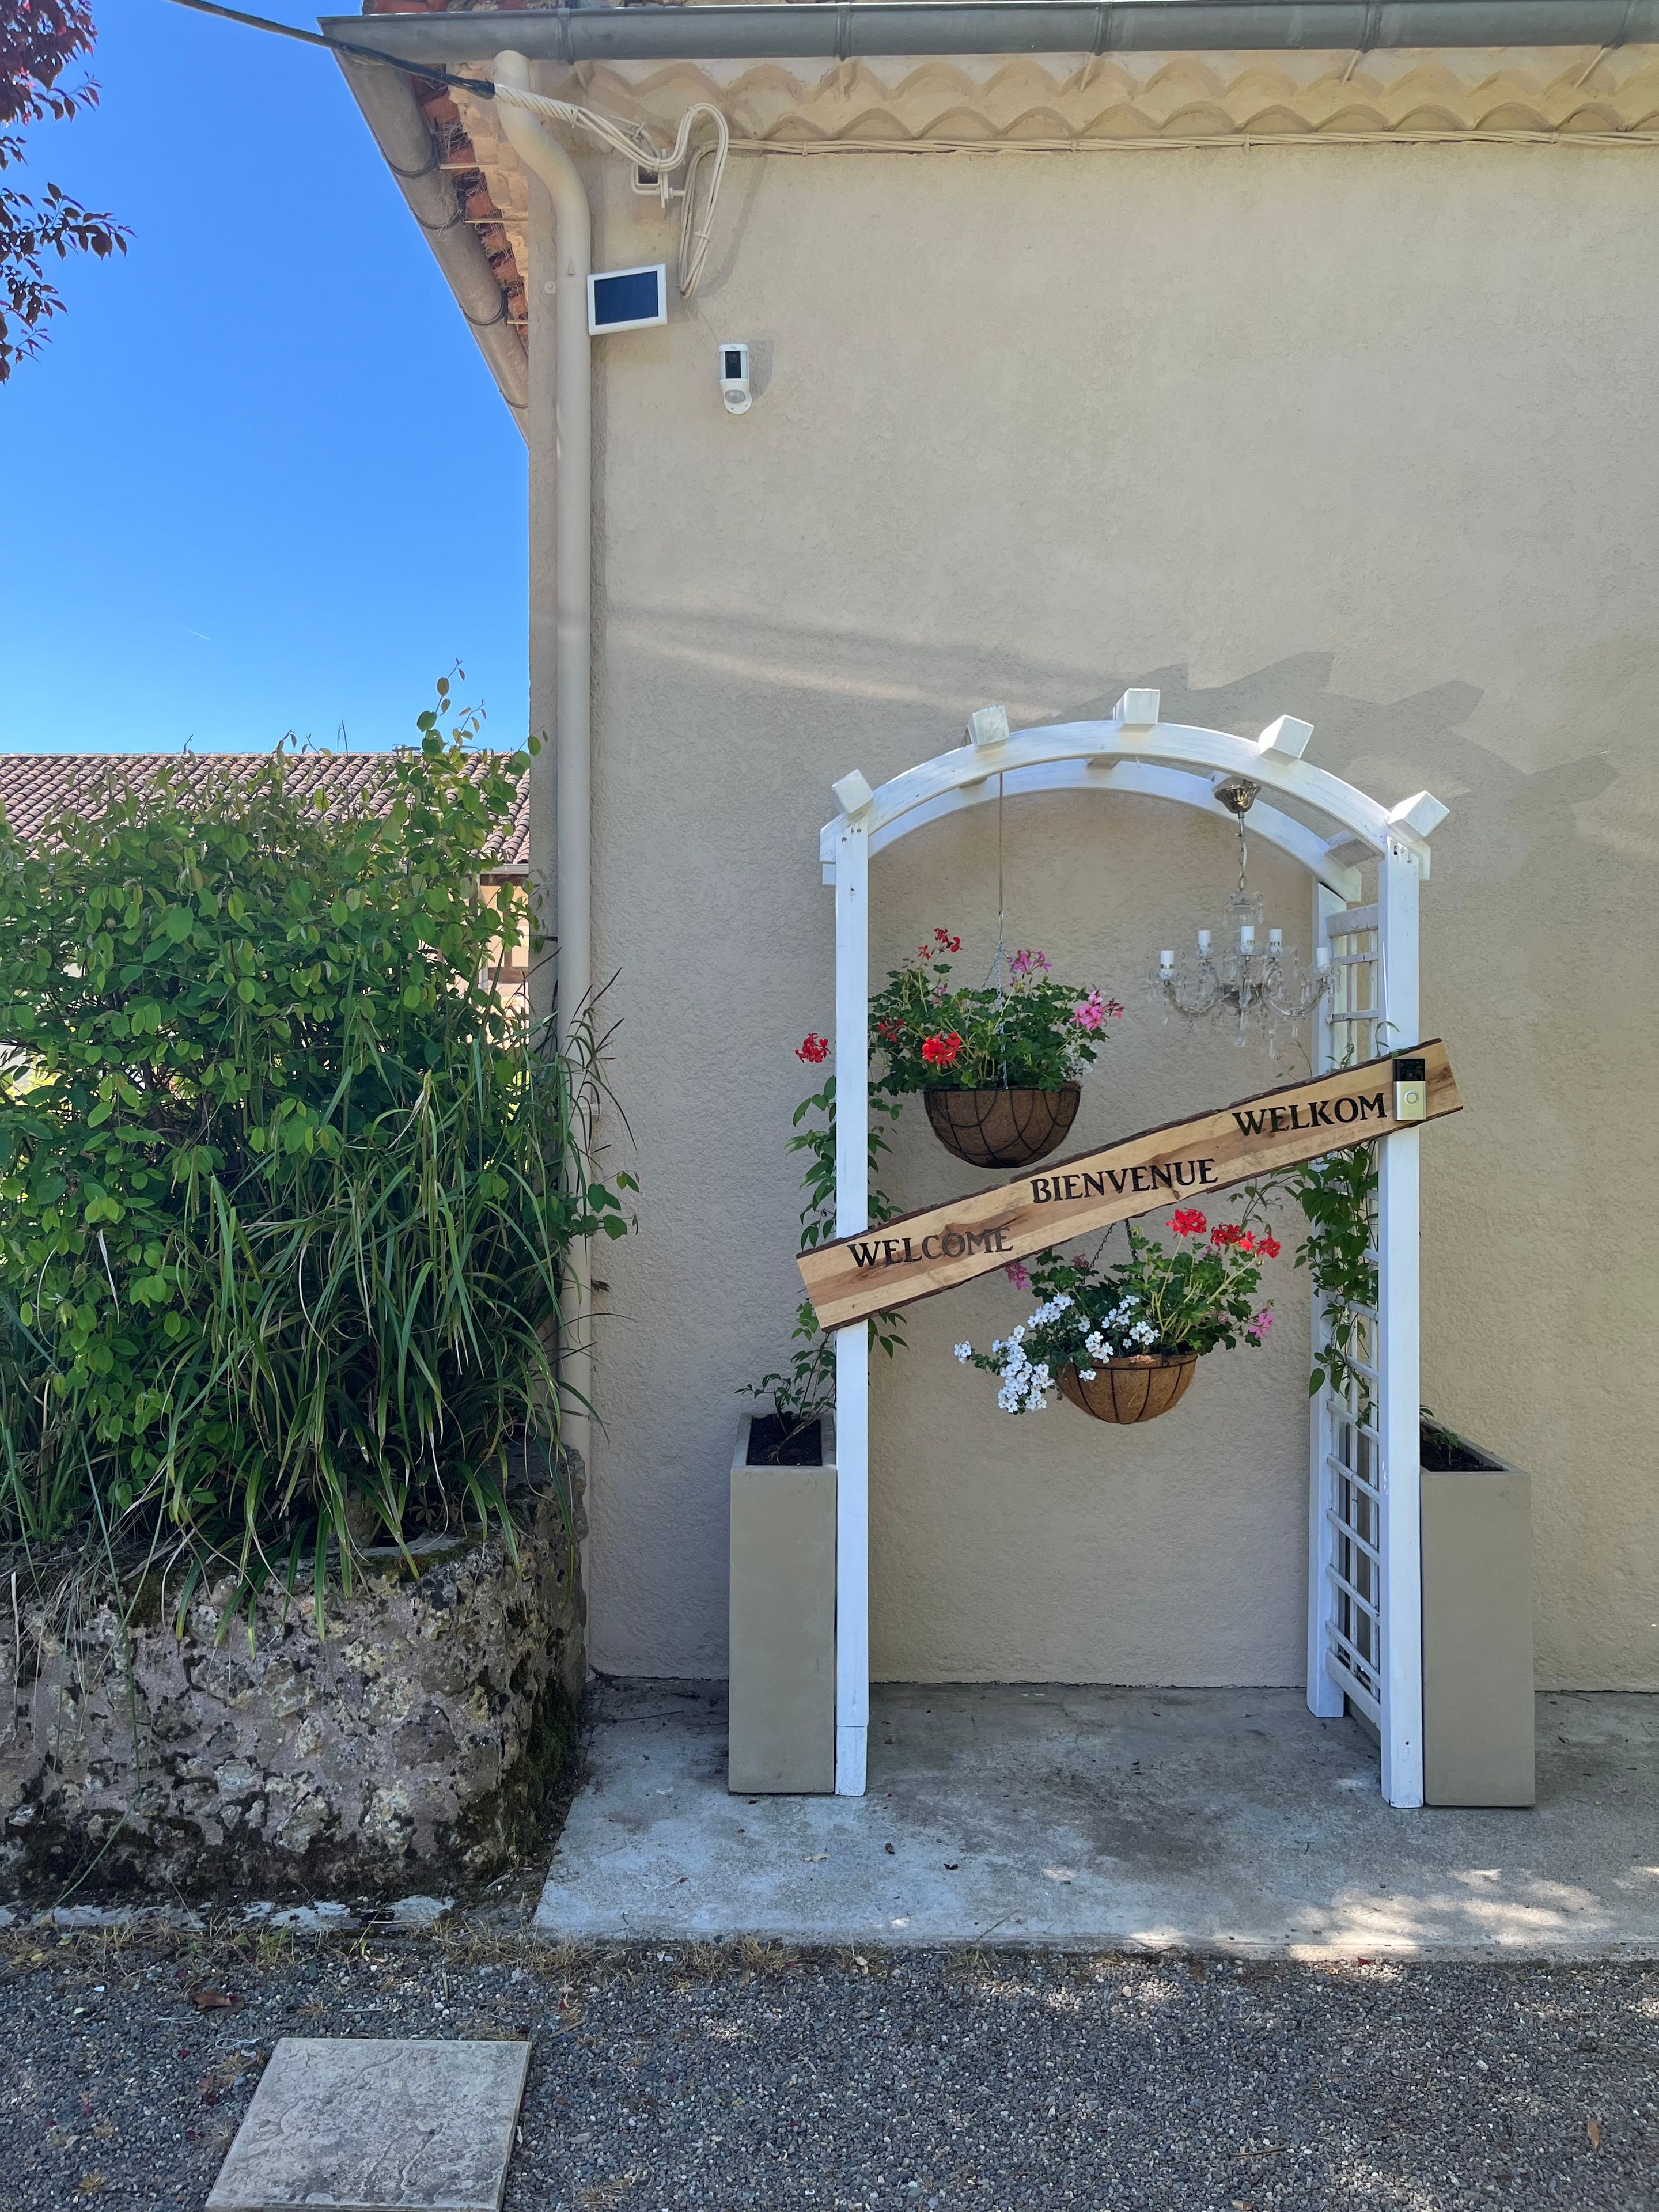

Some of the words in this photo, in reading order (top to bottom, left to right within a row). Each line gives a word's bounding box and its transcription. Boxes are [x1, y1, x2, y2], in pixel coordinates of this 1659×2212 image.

[847, 1226, 1013, 1267] WELCOME
[1029, 1158, 1219, 1204] BIENVENUE
[1232, 1092, 1388, 1137] WELKOM
